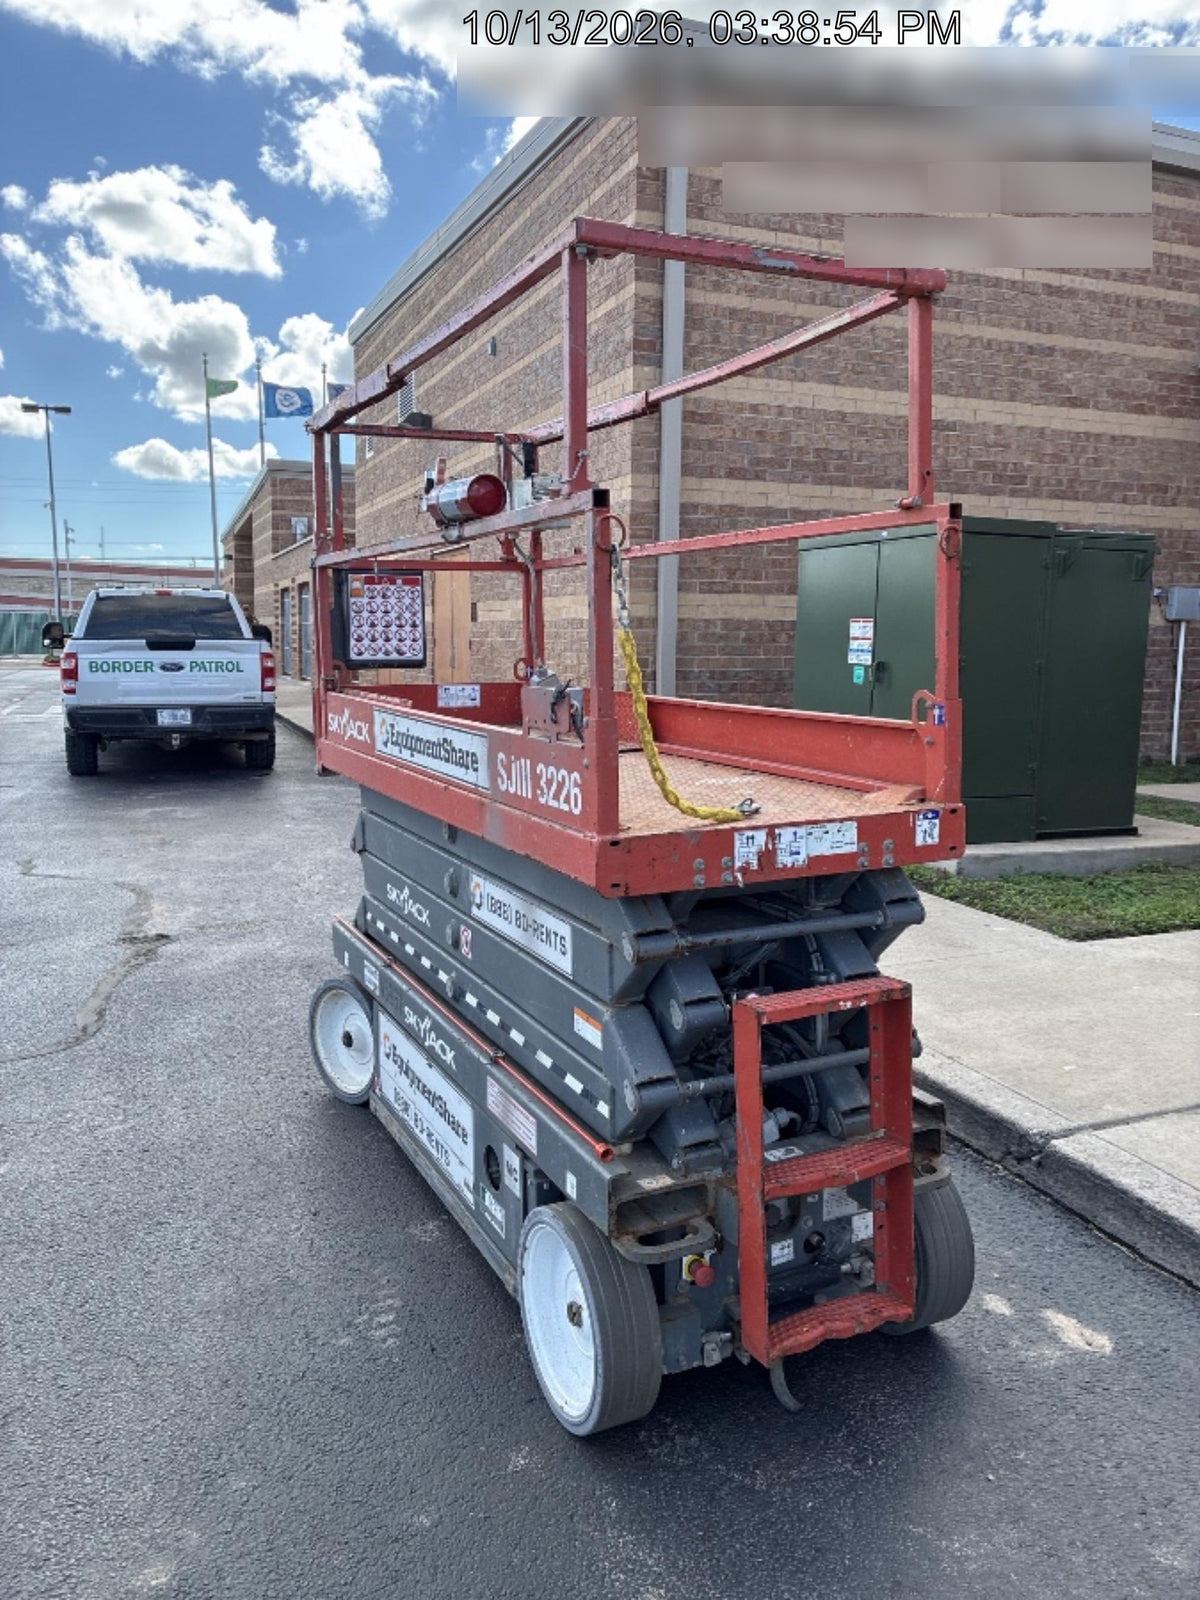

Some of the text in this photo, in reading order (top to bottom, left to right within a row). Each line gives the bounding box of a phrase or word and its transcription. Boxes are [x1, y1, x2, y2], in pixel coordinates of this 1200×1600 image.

[89, 660, 154, 674] BORDER
[188, 660, 244, 673] PATROL
[327, 707, 370, 743] SKYJACK
[388, 721, 479, 773] EquipmentShare
[536, 762, 582, 816] 3226
[386, 882, 430, 928] SKYJACK
[403, 1006, 457, 1072] SKYJACK
